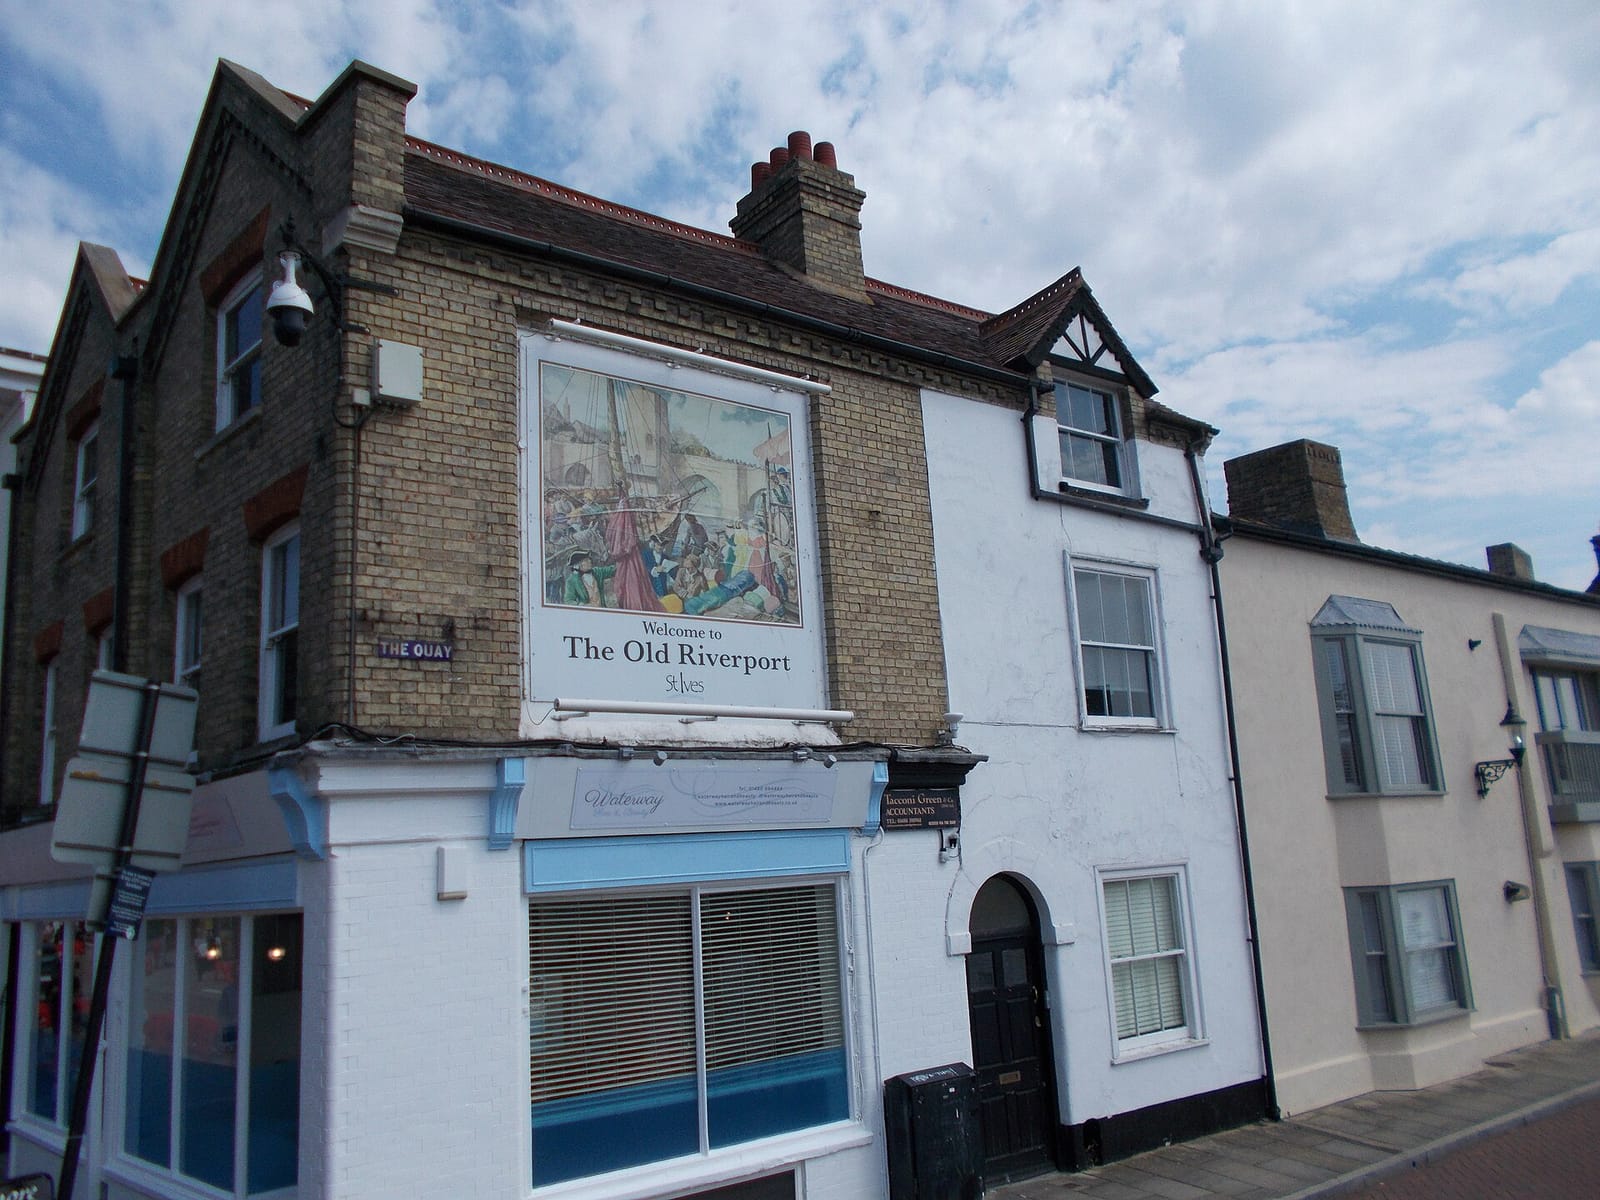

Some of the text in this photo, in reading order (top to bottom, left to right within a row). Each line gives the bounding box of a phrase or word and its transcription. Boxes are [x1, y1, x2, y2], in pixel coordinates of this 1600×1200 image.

[642, 620, 723, 640] Welcome to
[380, 641, 452, 658] THE QUAY
[563, 635, 791, 675] The Old Riverport
[584, 789, 665, 814] Waterway
[917, 793, 942, 805] Green
[886, 807, 935, 816] ACCOUNTANTS
